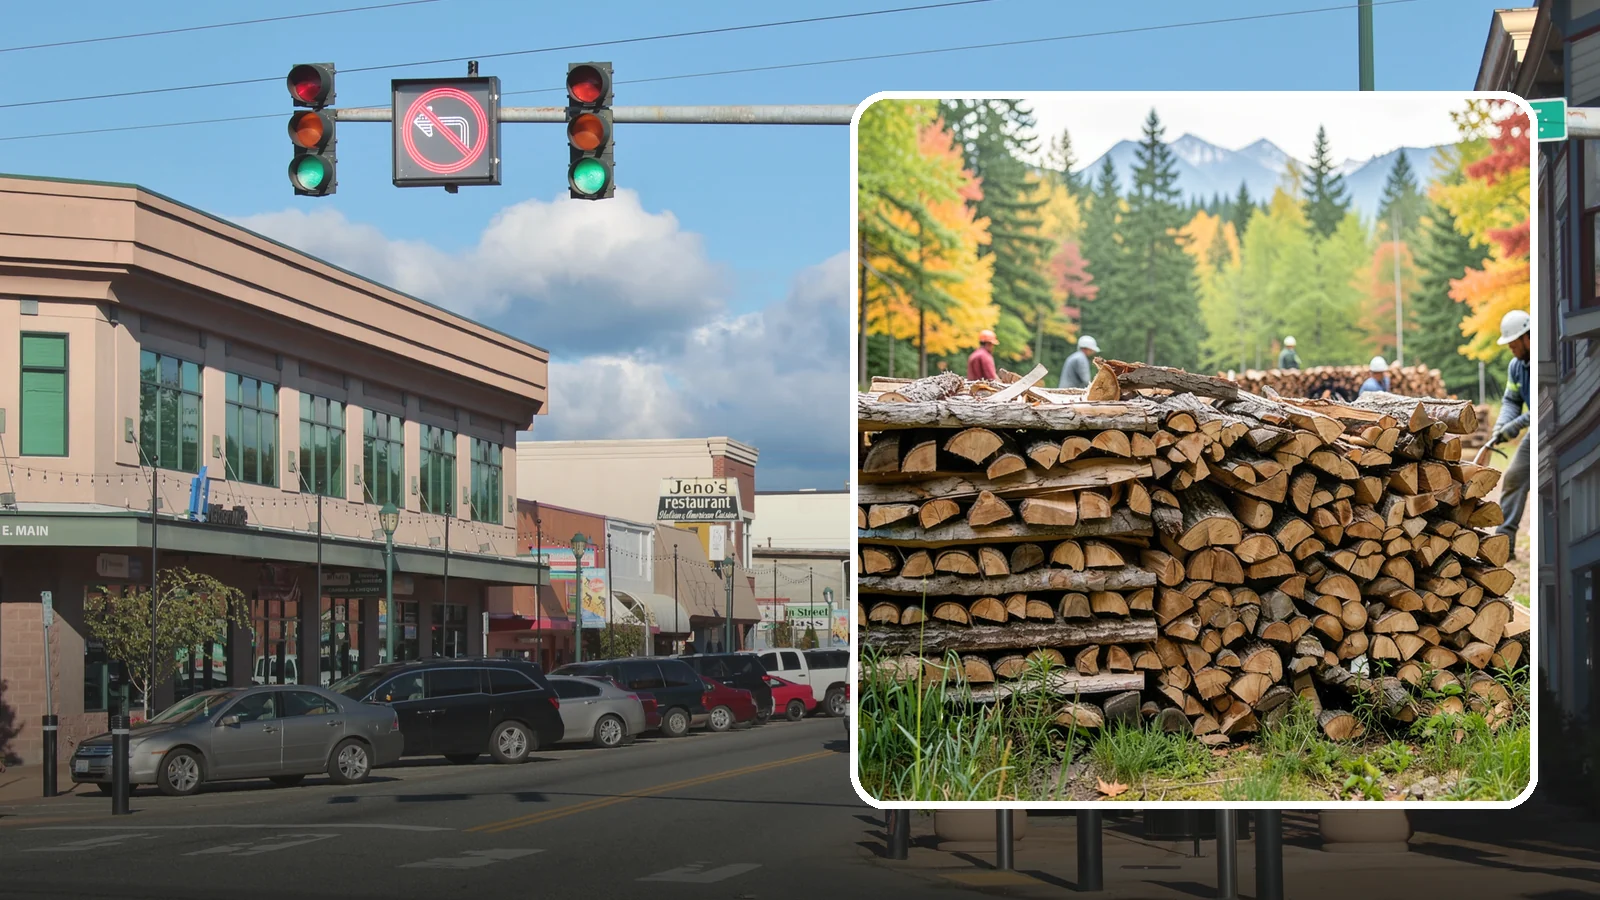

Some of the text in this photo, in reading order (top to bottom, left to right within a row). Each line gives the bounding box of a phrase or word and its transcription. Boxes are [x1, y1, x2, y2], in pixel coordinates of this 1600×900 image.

[670, 480, 727, 494] Jeno's
[665, 496, 731, 509] restaurant
[686, 510, 714, 519] American
[715, 509, 737, 519] Cuisine
[2, 525, 49, 536] E. MAIN
[797, 607, 828, 617] Street
[791, 619, 823, 627] lass
